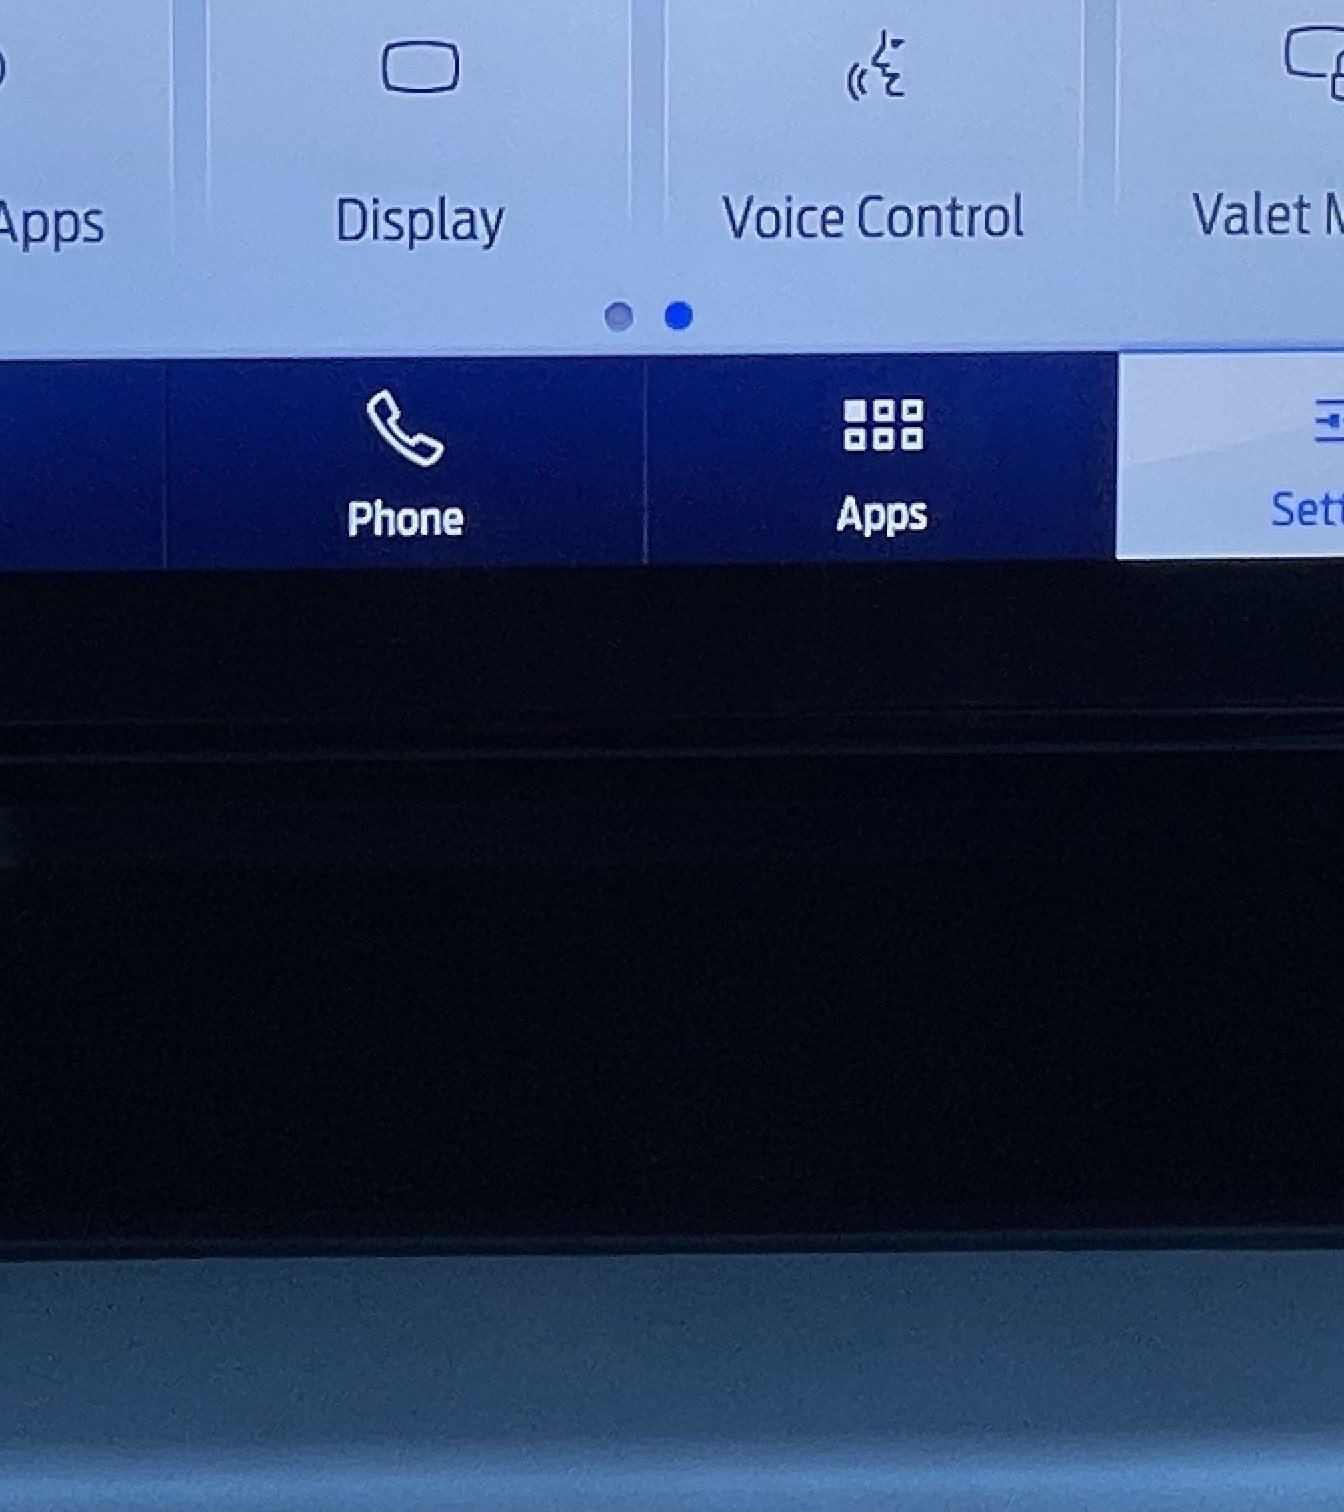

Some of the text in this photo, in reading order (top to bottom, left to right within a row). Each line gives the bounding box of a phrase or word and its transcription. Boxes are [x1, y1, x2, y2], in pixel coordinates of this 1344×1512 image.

[338, 194, 506, 251] Display
[722, 192, 1024, 240] Voice Control
[1192, 190, 1312, 236] Valet
[348, 498, 464, 538] Phone
[836, 494, 928, 538] Apps
